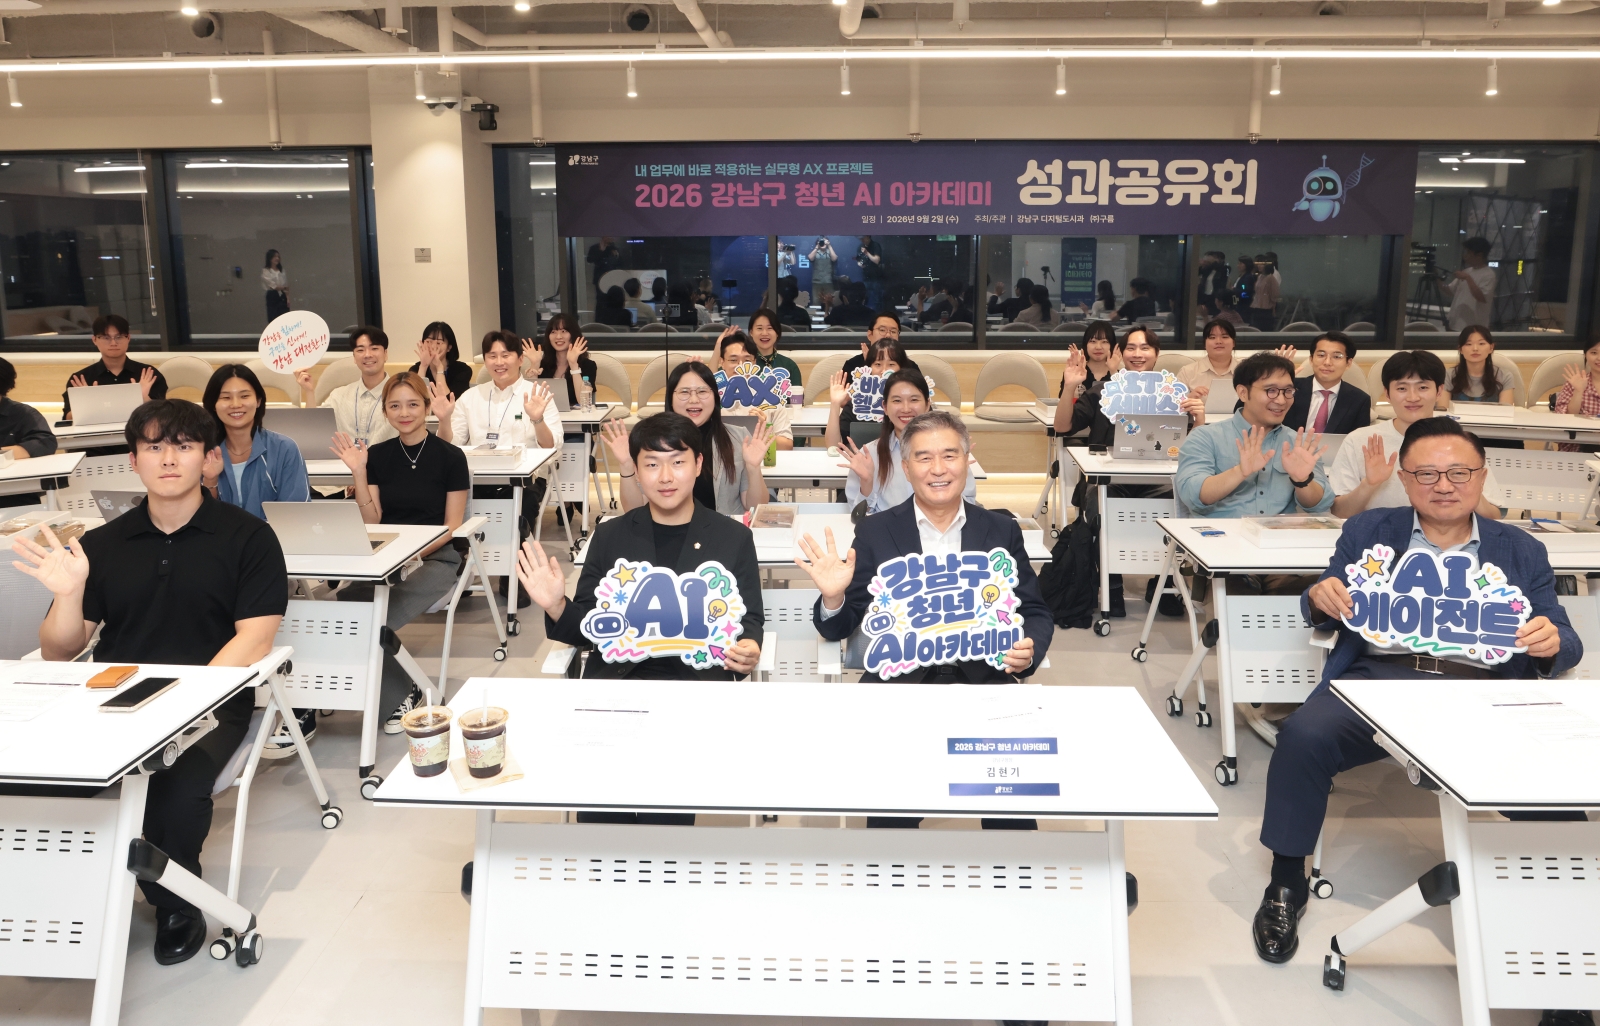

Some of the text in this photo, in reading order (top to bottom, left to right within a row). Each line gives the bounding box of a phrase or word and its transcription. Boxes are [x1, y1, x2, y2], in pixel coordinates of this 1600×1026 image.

[635, 162, 874, 177] 내 업무에 바로 적용하는 실무형 AX 프로젝트
[1017, 158, 1258, 206] 성과공유회
[635, 181, 992, 208] 2026 강남구 청년 AI 아카데미
[861, 215, 959, 225] 일정 2026년 9월 2일 (수)
[974, 214, 1006, 224] 주최/주관
[1016, 214, 1039, 224] 강남구
[1040, 214, 1085, 224] 디지털도시과
[273, 352, 293, 370] 강남
[721, 374, 781, 409] AX
[1123, 371, 1164, 394] IT
[1105, 393, 1180, 416] 서비스
[880, 553, 991, 601] 강남구
[1392, 552, 1472, 600] AI
[624, 572, 710, 640] AI
[906, 588, 976, 630] 청년
[1349, 589, 1521, 648] 에이전트
[954, 742, 1050, 752] 2026 강남구 청년 AI 아카데미
